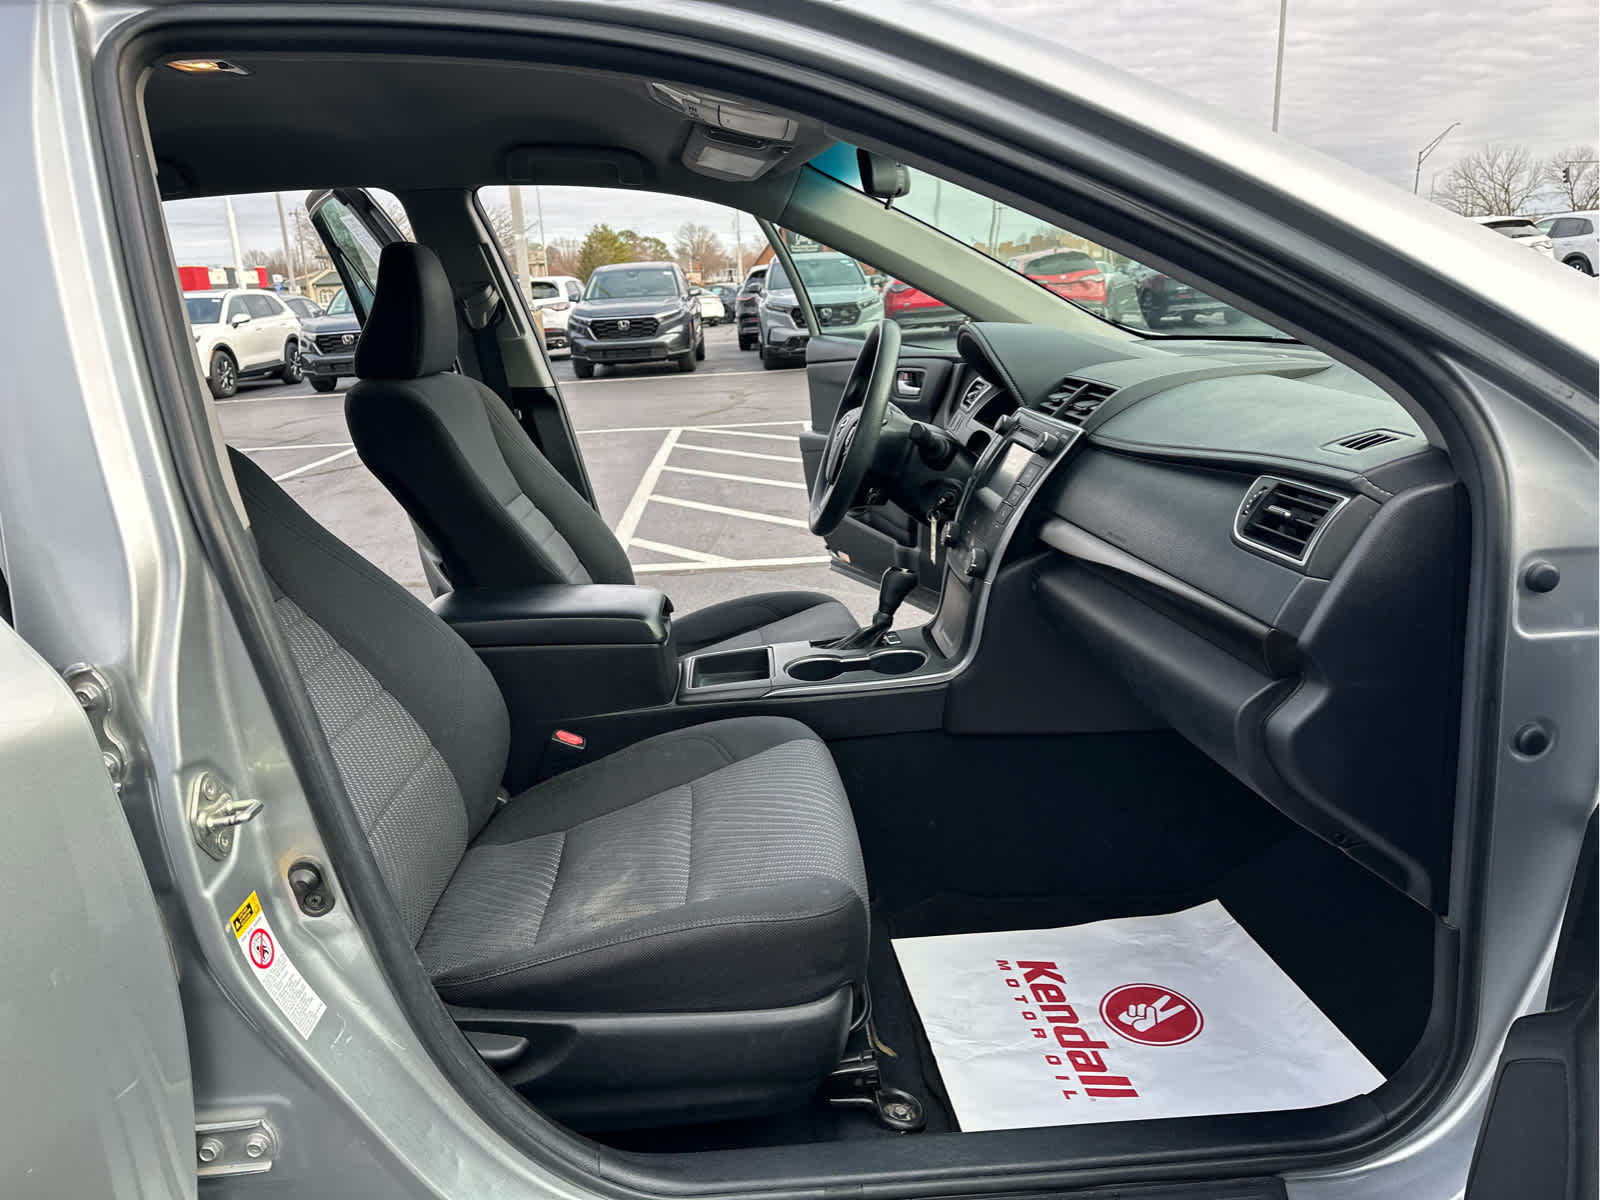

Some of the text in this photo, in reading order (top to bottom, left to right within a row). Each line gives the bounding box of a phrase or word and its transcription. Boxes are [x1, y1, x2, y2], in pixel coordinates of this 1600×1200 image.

[996, 959, 1078, 1100] MOTOR OIL
[1016, 960, 1139, 1099] Kendall
